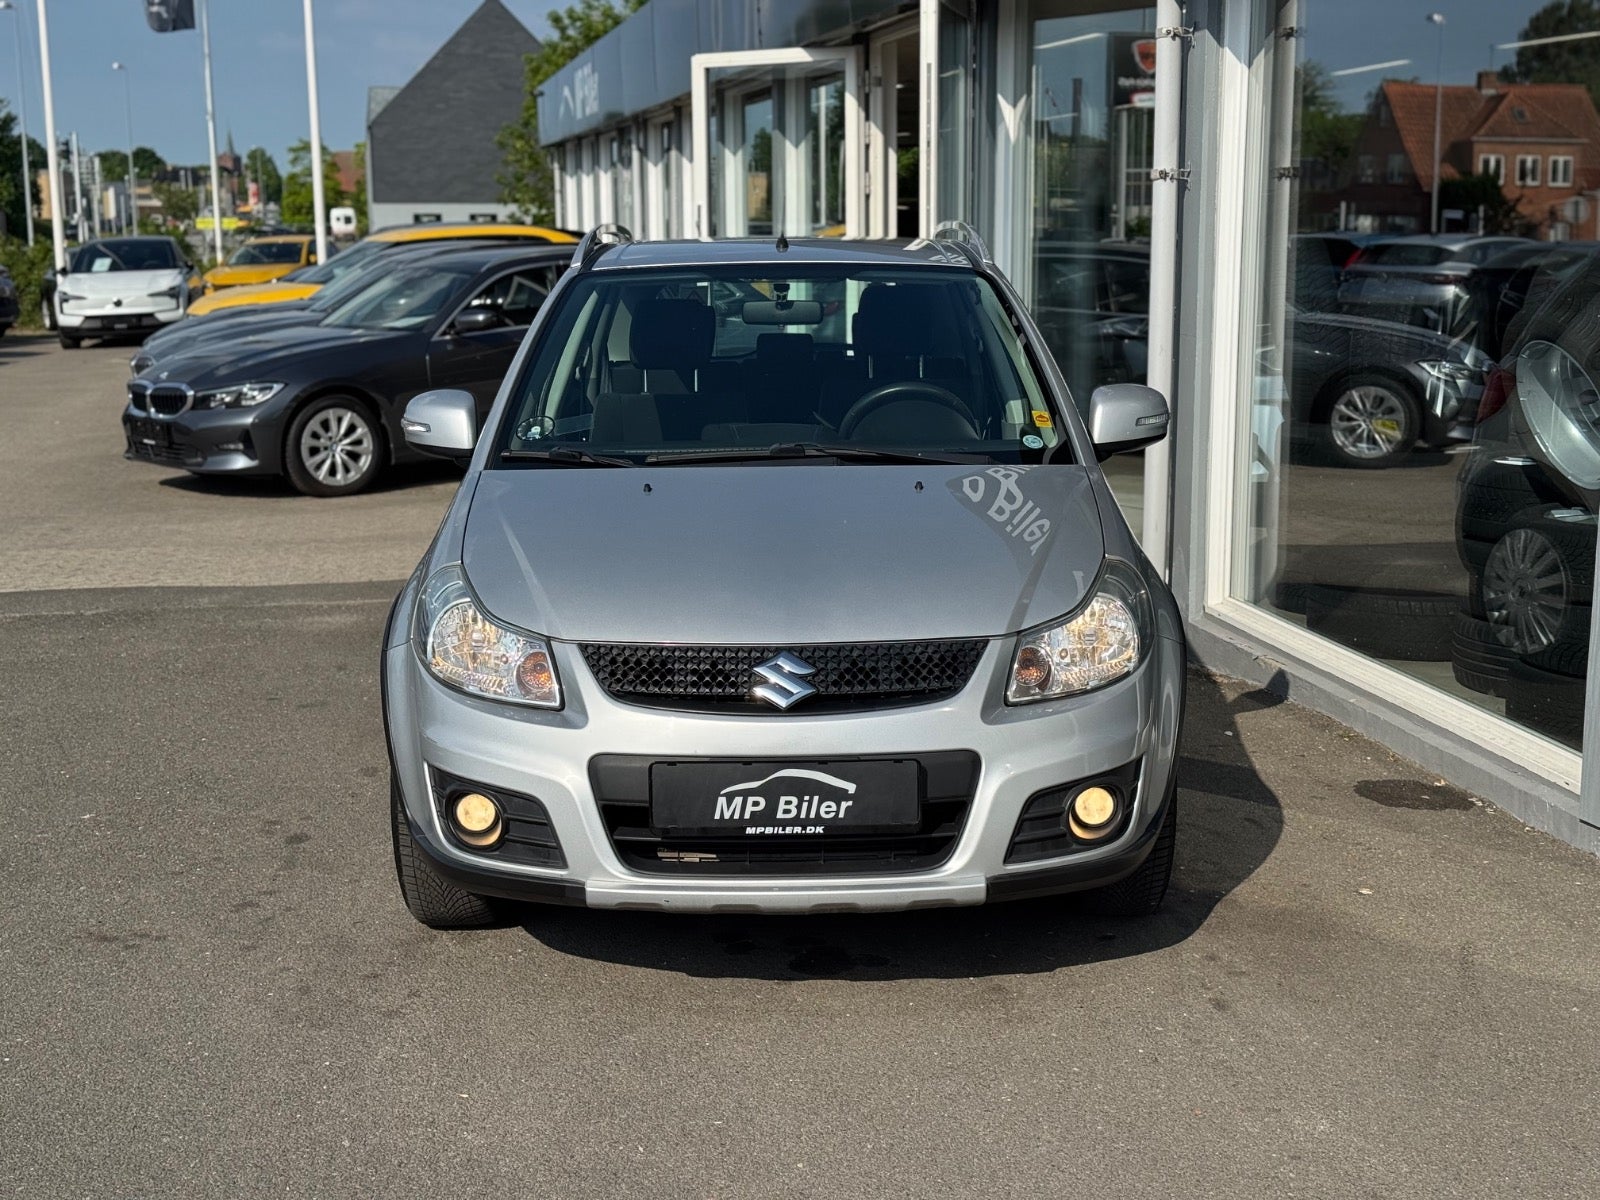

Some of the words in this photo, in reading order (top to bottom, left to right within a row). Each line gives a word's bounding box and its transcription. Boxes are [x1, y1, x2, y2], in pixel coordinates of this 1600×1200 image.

[714, 796, 766, 820] MP
[776, 795, 853, 819] Biler
[745, 826, 825, 836] MPBILER.DK
